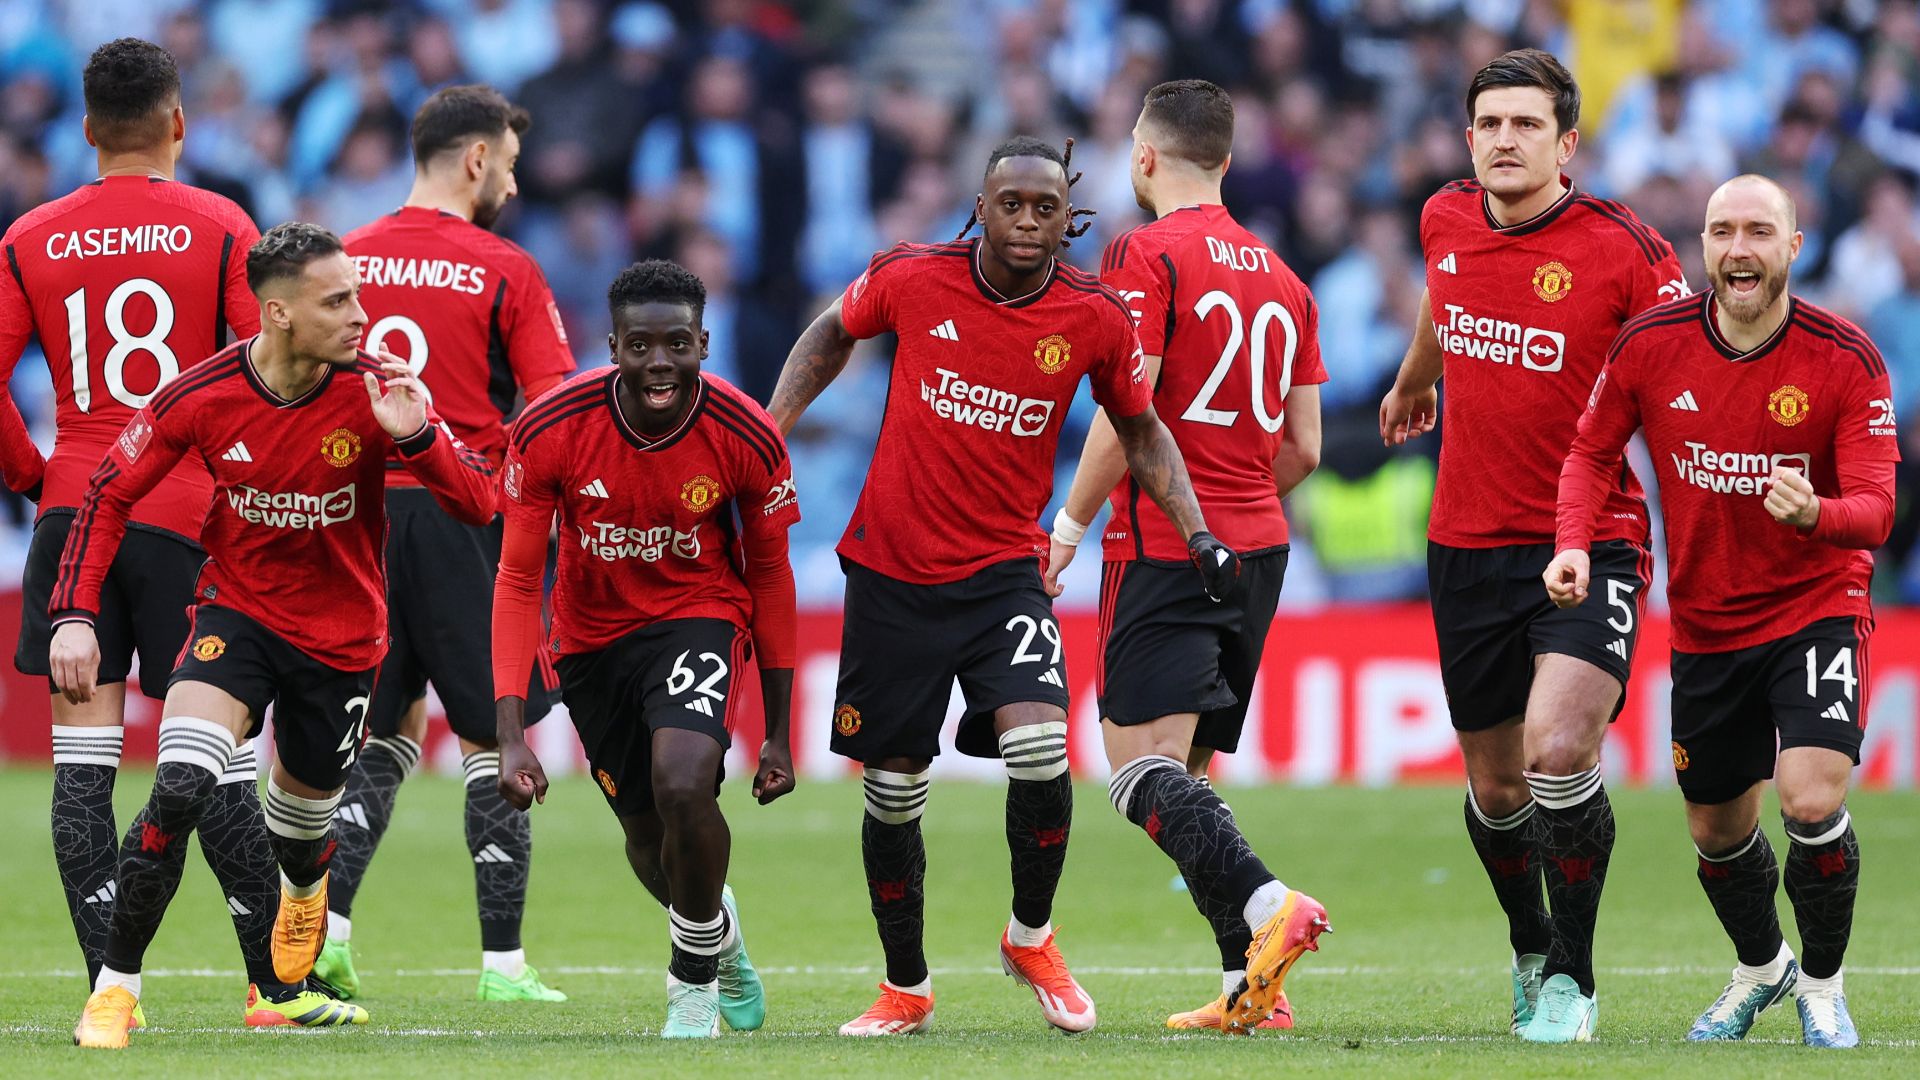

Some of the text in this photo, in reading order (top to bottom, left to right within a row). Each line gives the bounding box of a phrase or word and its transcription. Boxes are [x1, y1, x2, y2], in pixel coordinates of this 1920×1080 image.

[46, 224, 192, 260] CASEMIRO
[1205, 235, 1268, 273] DALOT
[1432, 320, 1519, 365] Viewer
[1444, 303, 1521, 344] Team
[64, 277, 180, 415] 18
[1180, 289, 1298, 434] 20
[920, 376, 1012, 436] Viewer
[935, 367, 1018, 414] Team
[1671, 452, 1770, 496] Viewer
[1684, 440, 1769, 475] Team
[226, 487, 320, 531] Viewer
[238, 484, 320, 513] Team
[576, 524, 671, 563] Viewer
[592, 520, 672, 548] Team
[1606, 578, 1635, 634] 5
[1005, 615, 1062, 666] 29
[666, 649, 729, 701] 62
[1805, 644, 1858, 702] 14
